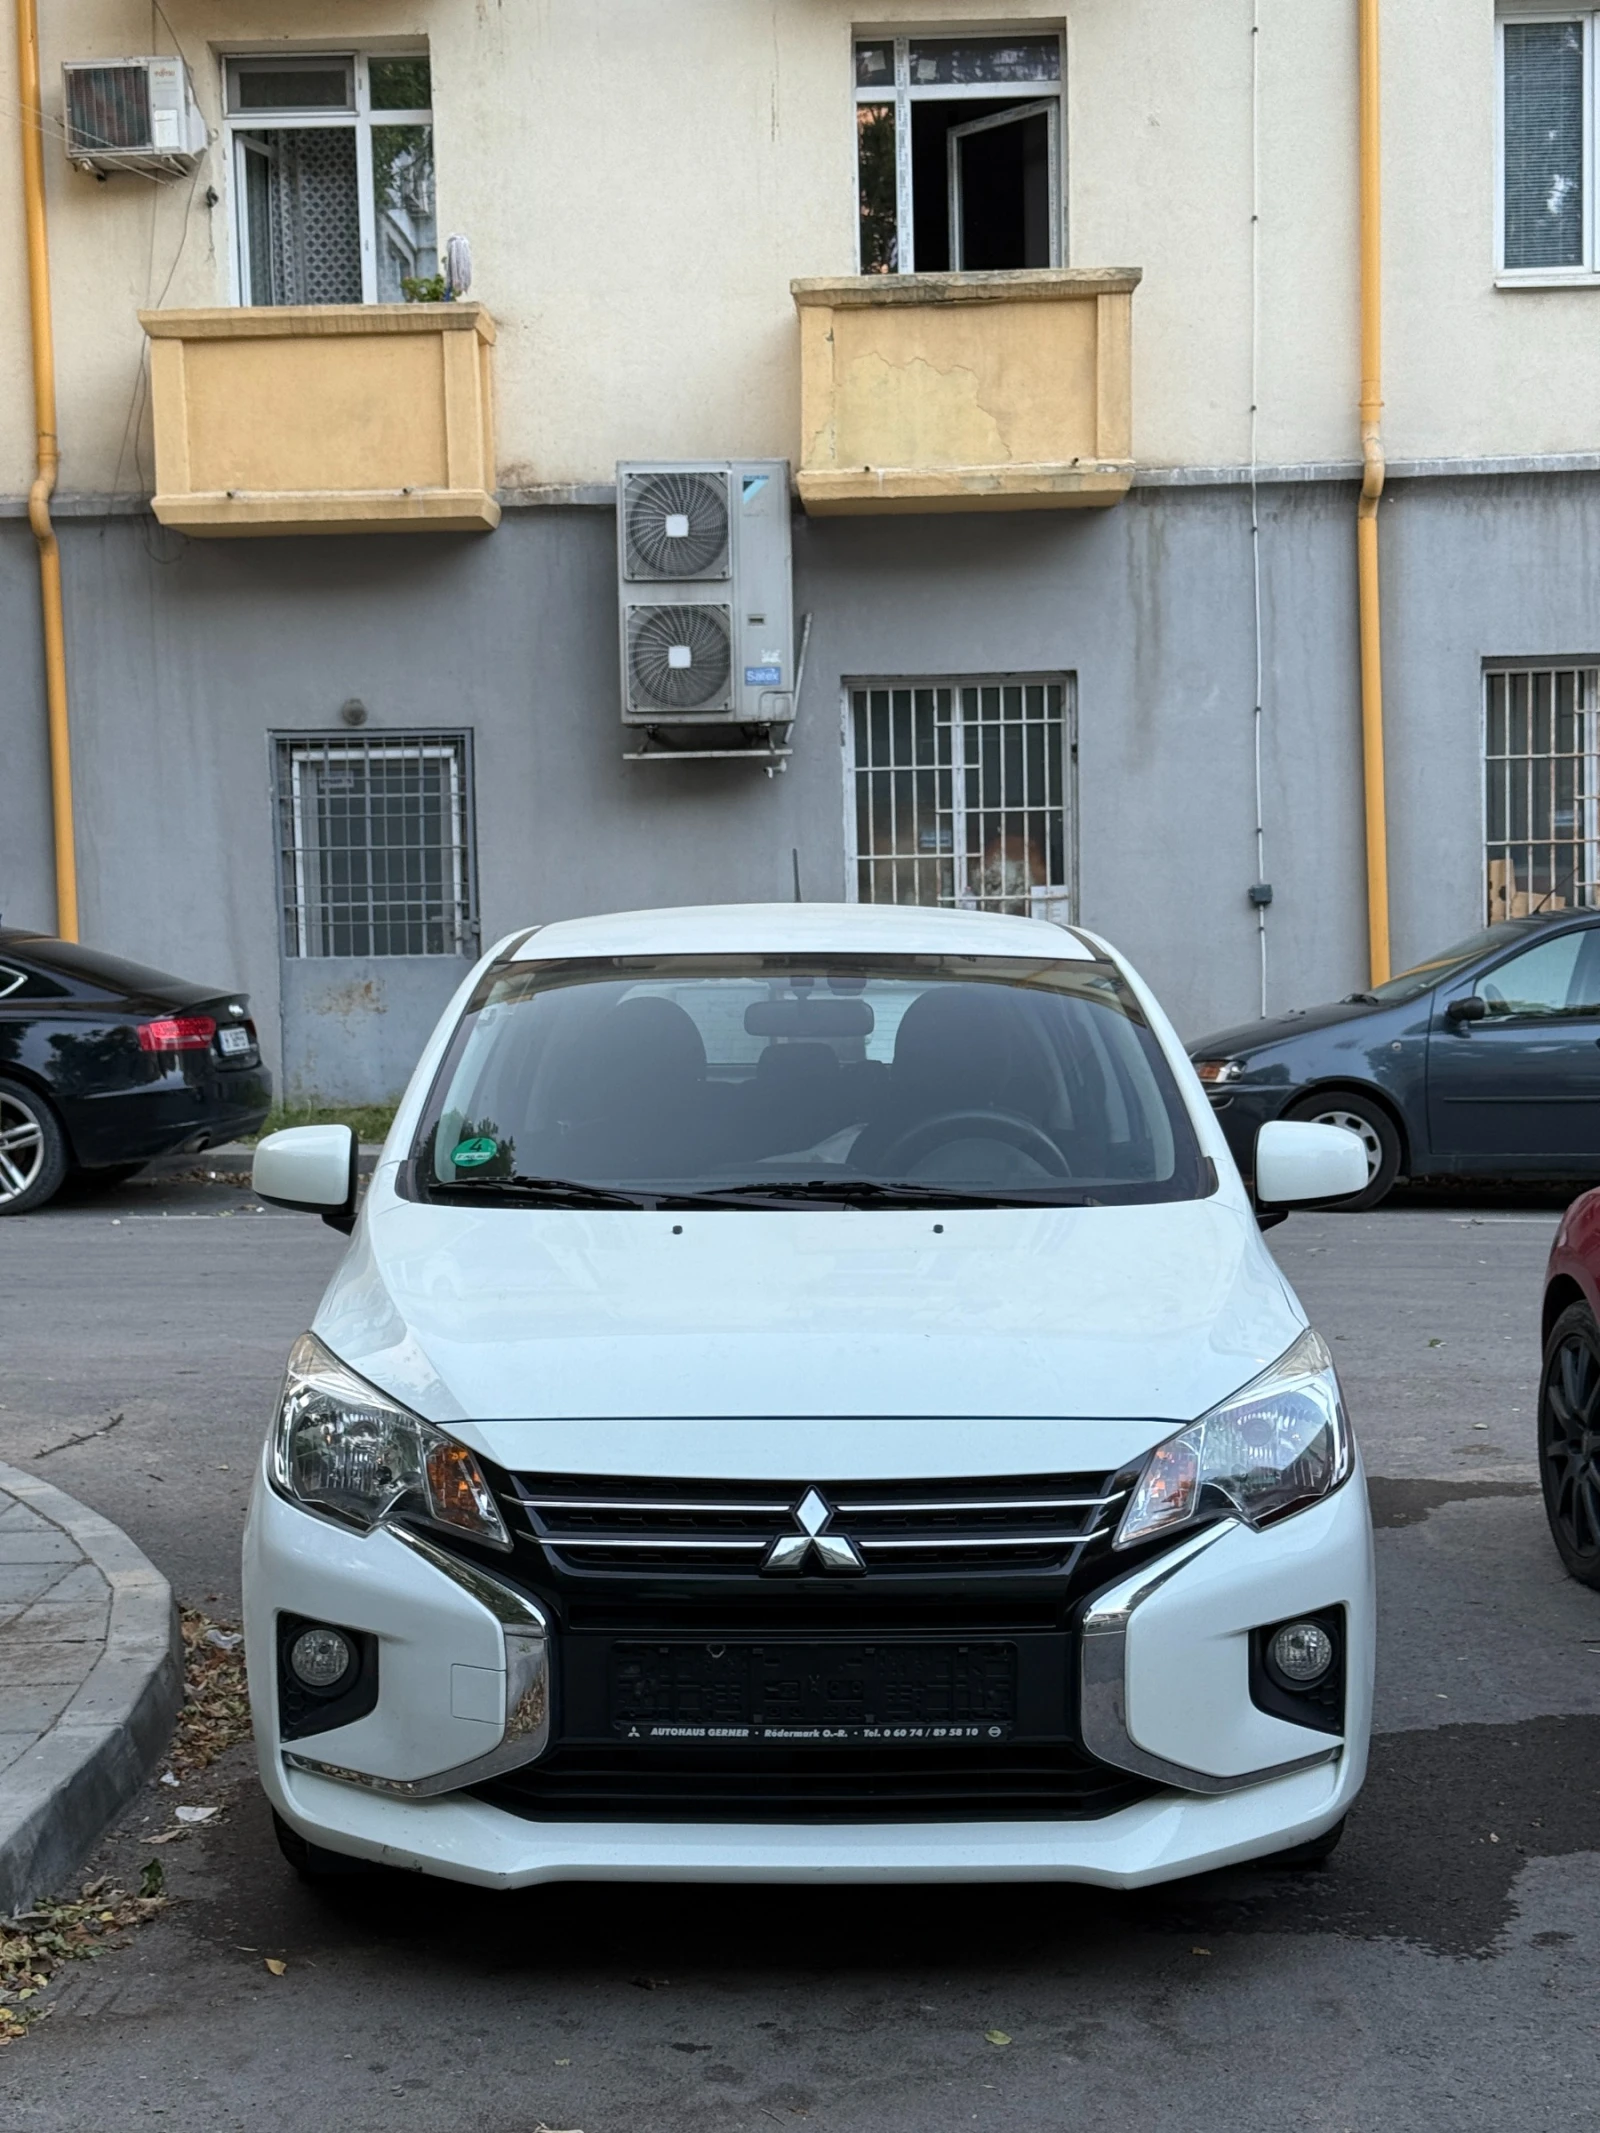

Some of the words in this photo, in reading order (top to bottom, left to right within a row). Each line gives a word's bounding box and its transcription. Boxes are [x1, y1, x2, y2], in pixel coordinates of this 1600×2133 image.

[469, 1138, 483, 1152] 4
[650, 1727, 706, 1737] AUTOHAUS
[707, 1728, 750, 1737] GERNER
[764, 1728, 820, 1738] Rödermark
[863, 1728, 881, 1738] Tel.
[893, 1728, 907, 1737] 60
[909, 1728, 923, 1737] 74
[965, 1727, 979, 1736] 10
